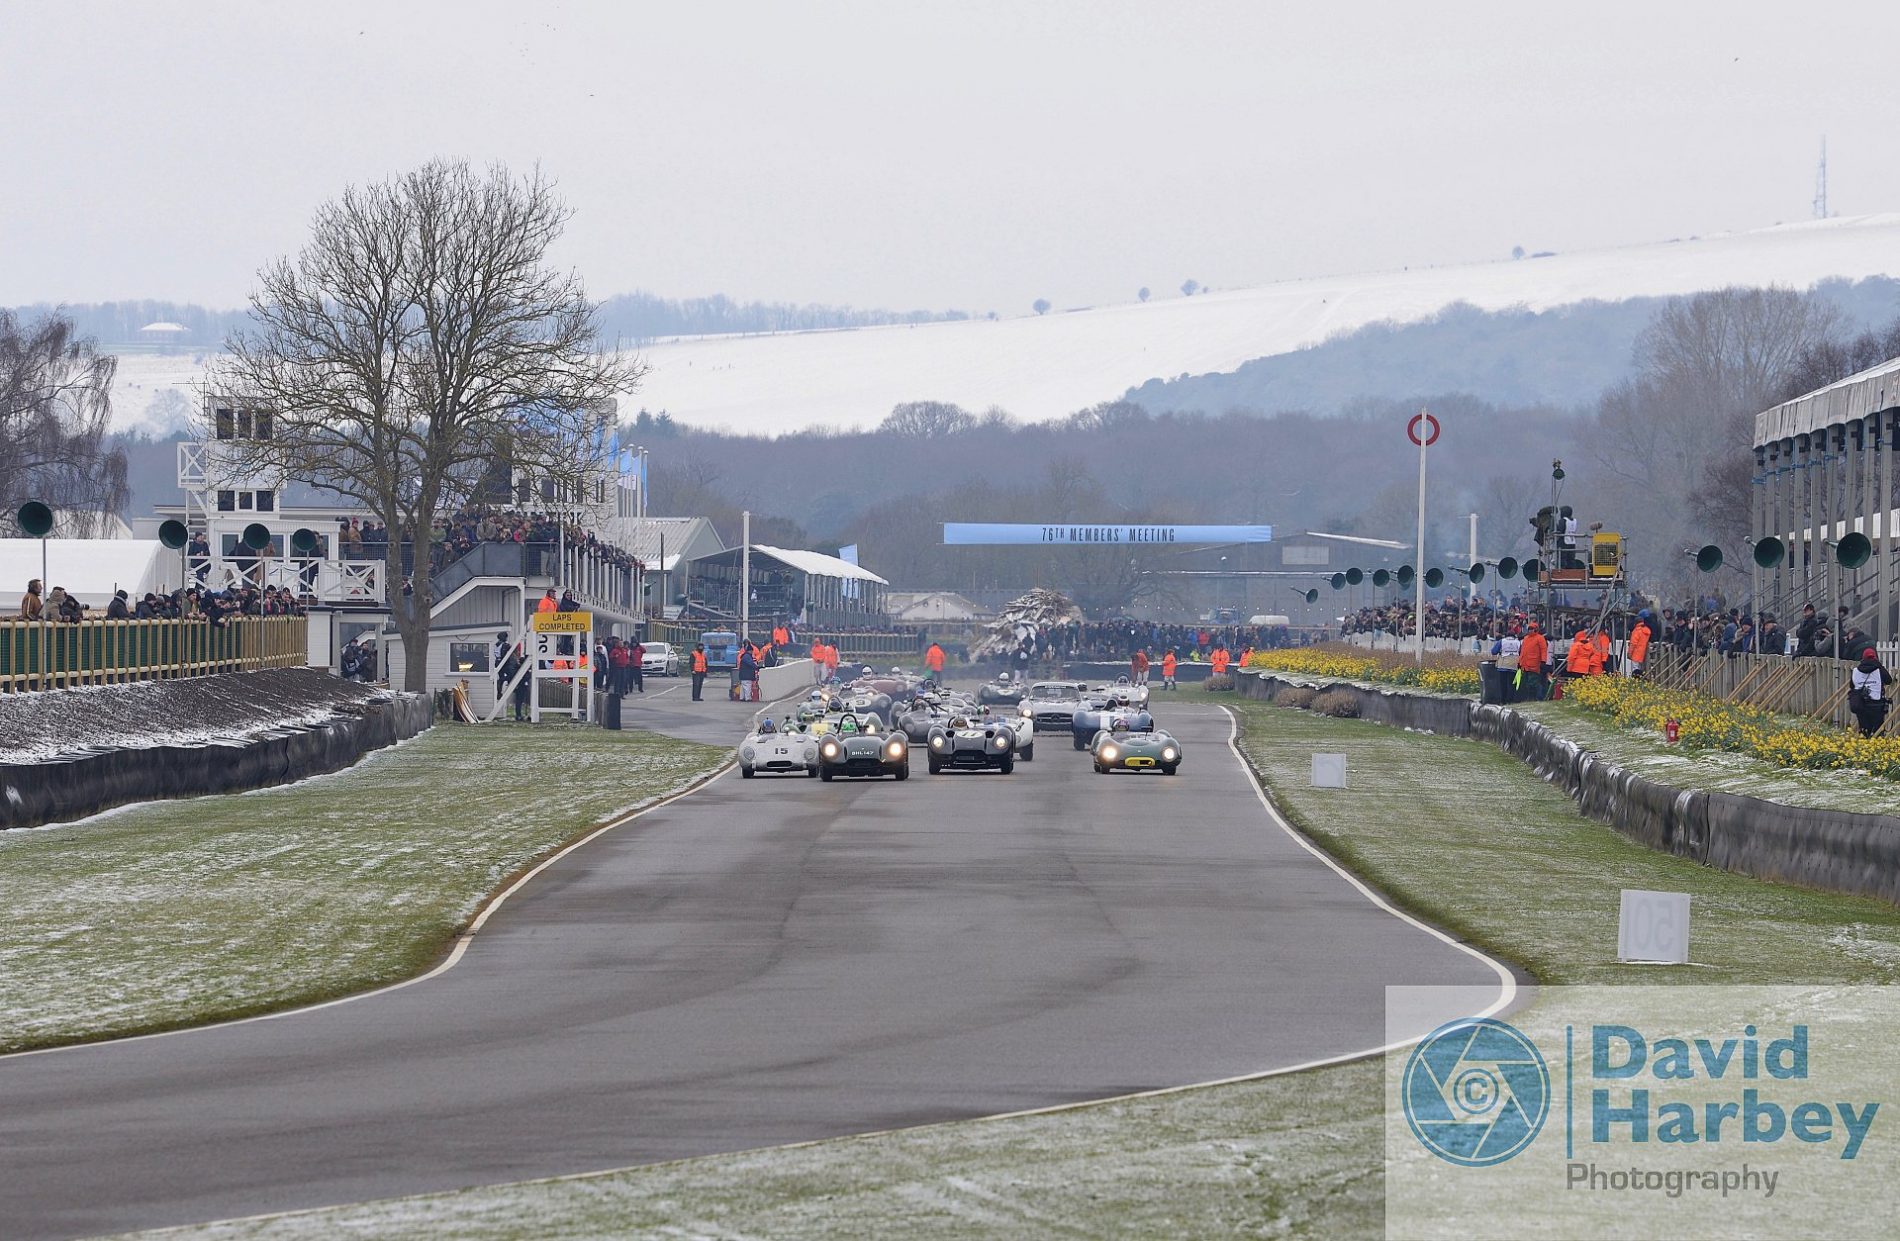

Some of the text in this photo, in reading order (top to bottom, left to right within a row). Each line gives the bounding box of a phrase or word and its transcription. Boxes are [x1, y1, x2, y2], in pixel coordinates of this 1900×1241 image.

[1042, 528, 1175, 542] 76TH MEMBERS' MEETING
[552, 613, 572, 622] LAPS
[538, 623, 586, 631] COMPLETED
[775, 747, 789, 755] 15
